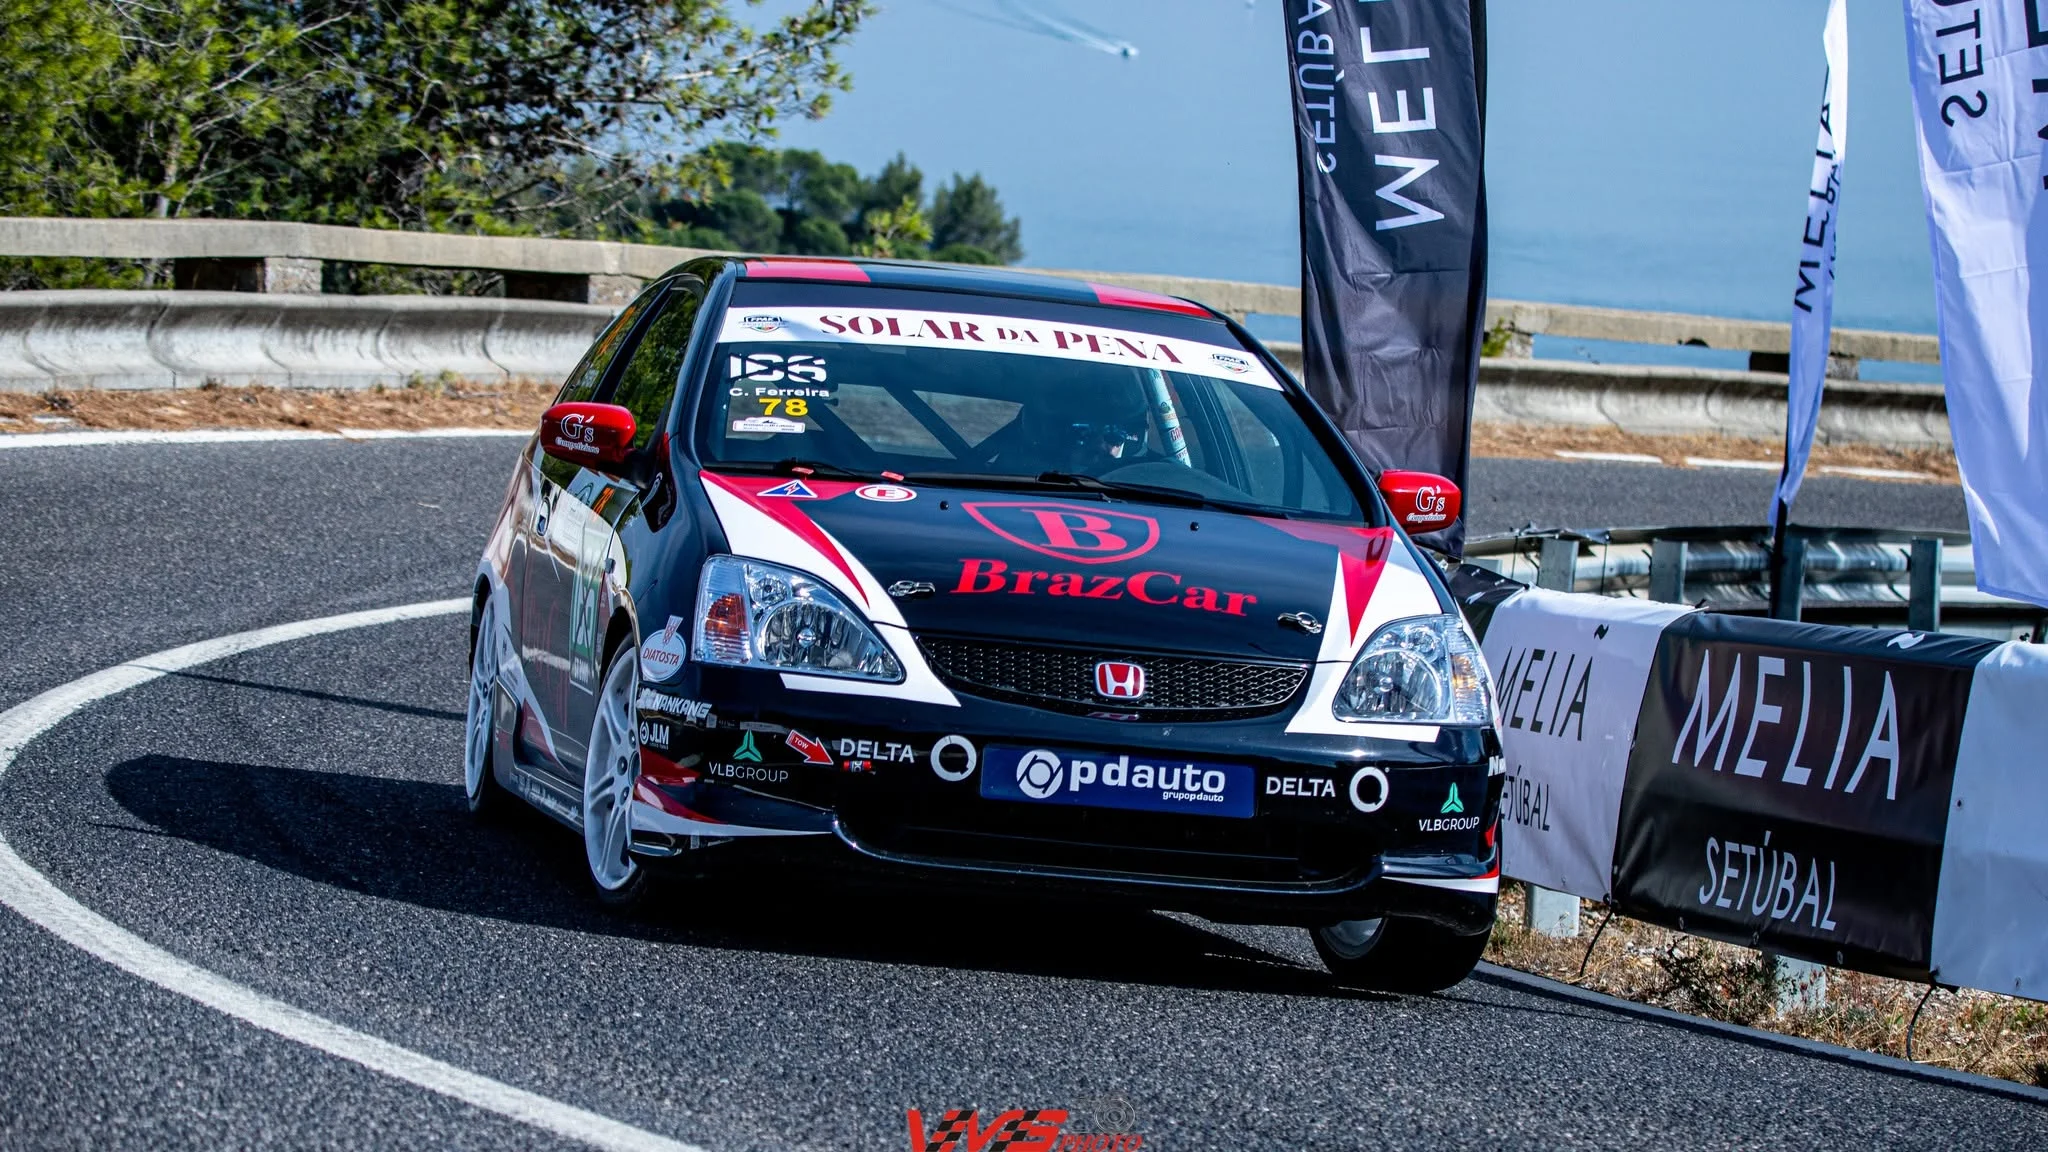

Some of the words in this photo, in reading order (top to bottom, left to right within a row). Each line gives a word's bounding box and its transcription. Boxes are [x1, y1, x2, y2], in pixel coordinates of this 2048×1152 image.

[820, 315, 984, 342] SOLAR
[997, 327, 1039, 343] DA
[1055, 330, 1184, 365] PENA
[729, 388, 749, 397] C.
[755, 387, 830, 398] Ferreira
[759, 398, 808, 416] 78
[1032, 509, 1128, 552] B
[950, 558, 1258, 616] BrazCar
[643, 647, 680, 666] DIATOSTA
[652, 694, 712, 719] NANKANG
[1497, 646, 1594, 742] MELIA
[650, 722, 670, 745] JLM
[1671, 648, 1901, 801] MELIA
[794, 737, 809, 749] TOW
[840, 738, 915, 763] DELTA
[708, 761, 789, 783] VLBGROUP
[1069, 755, 1226, 794] pdauto
[1162, 790, 1224, 803] grupopdauto
[1266, 776, 1336, 798] DELTA
[1500, 765, 1551, 832] ETÚBAL
[1418, 816, 1480, 832] VLBGROUP
[1699, 830, 1838, 932] SETÚBAL
